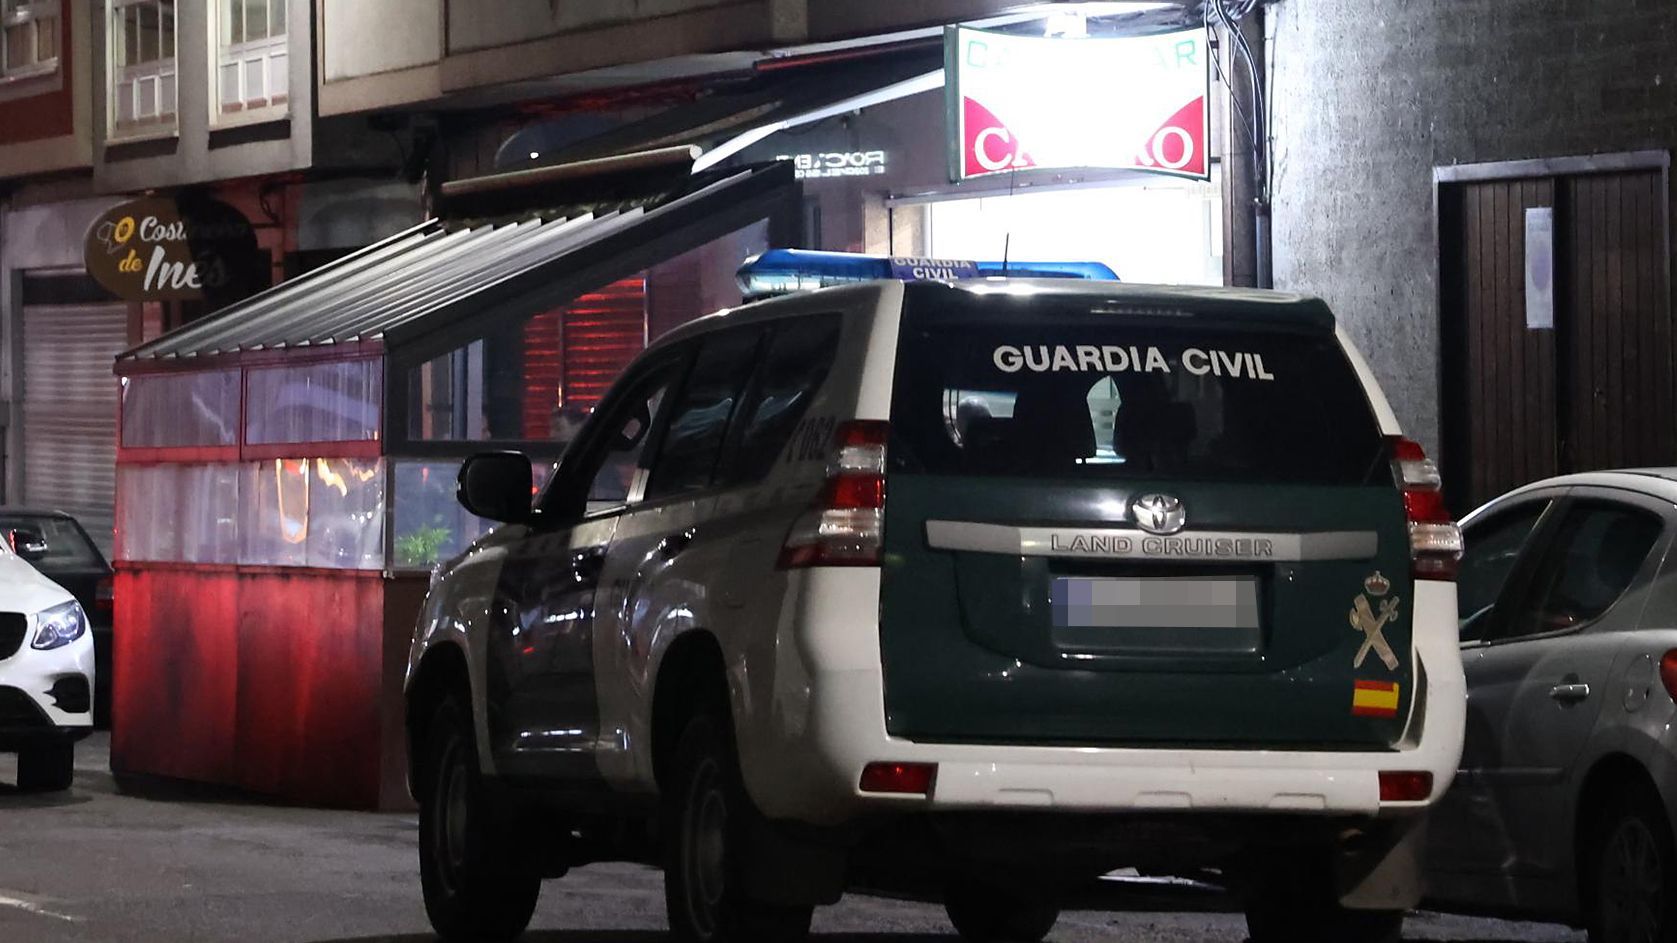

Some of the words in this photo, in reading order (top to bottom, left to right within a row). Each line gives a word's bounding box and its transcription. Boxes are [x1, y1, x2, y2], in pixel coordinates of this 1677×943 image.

[119, 249, 142, 272] de
[895, 257, 972, 268] GUARDIA
[912, 267, 959, 280] CIVIL
[993, 345, 1171, 373] GUARDIA
[1181, 348, 1275, 381] CIVIL
[1051, 533, 1133, 554] LAND
[1142, 536, 1274, 557] CRUISER
